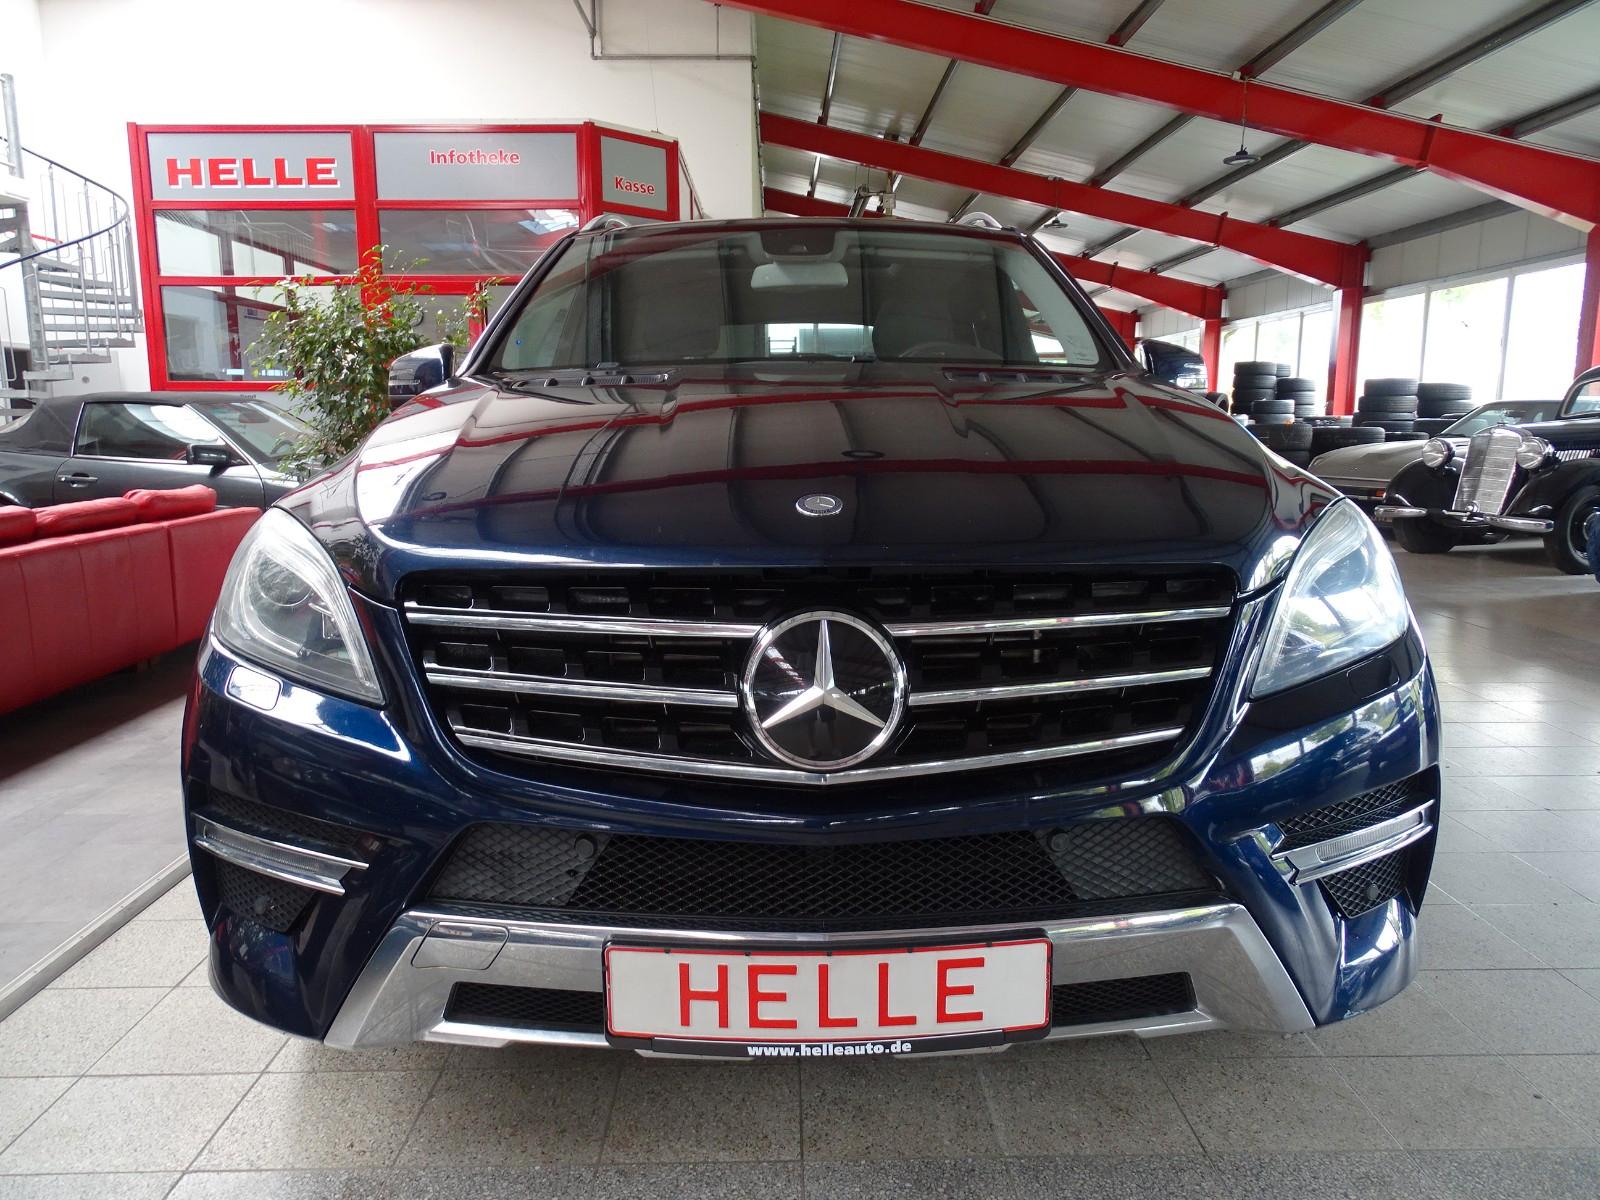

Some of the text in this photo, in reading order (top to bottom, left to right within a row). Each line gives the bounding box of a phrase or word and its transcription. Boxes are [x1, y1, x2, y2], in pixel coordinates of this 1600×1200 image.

[430, 150, 520, 165] Infotheke
[166, 157, 340, 189] HELLE
[614, 175, 656, 195] Kasse
[678, 956, 985, 1030] HELLE
[747, 1039, 912, 1057] www.helleauto.de
